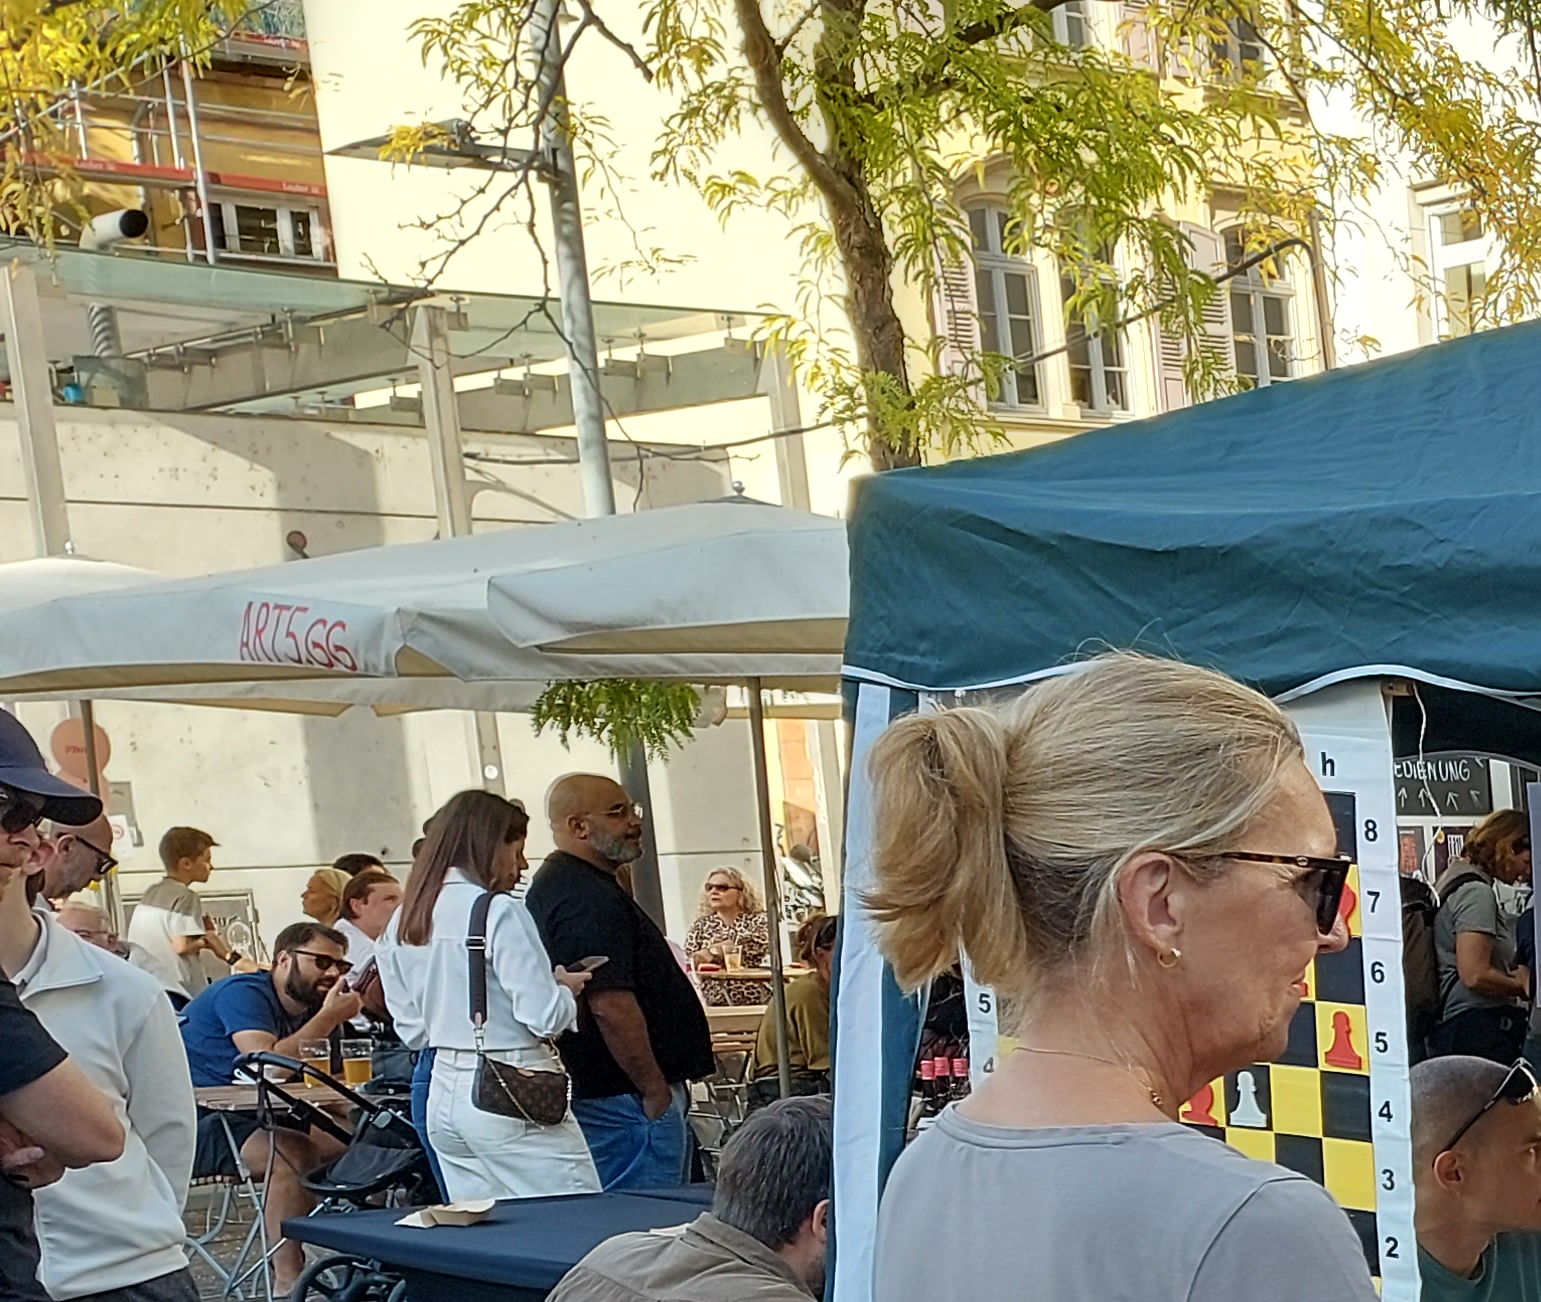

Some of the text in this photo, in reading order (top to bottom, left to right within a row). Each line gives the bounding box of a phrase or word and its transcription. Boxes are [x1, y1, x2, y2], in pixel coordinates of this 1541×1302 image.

[1320, 751, 1335, 777] h
[1394, 759, 1471, 782] EDIENUNG
[1364, 819, 1378, 842] 8
[1367, 891, 1381, 914] 7
[1370, 961, 1385, 984] 6
[978, 993, 992, 1014] 5
[1374, 1031, 1389, 1054] 5
[1378, 1100, 1393, 1123] 4
[1381, 1168, 1395, 1191] 3
[1385, 1236, 1399, 1259] 2
